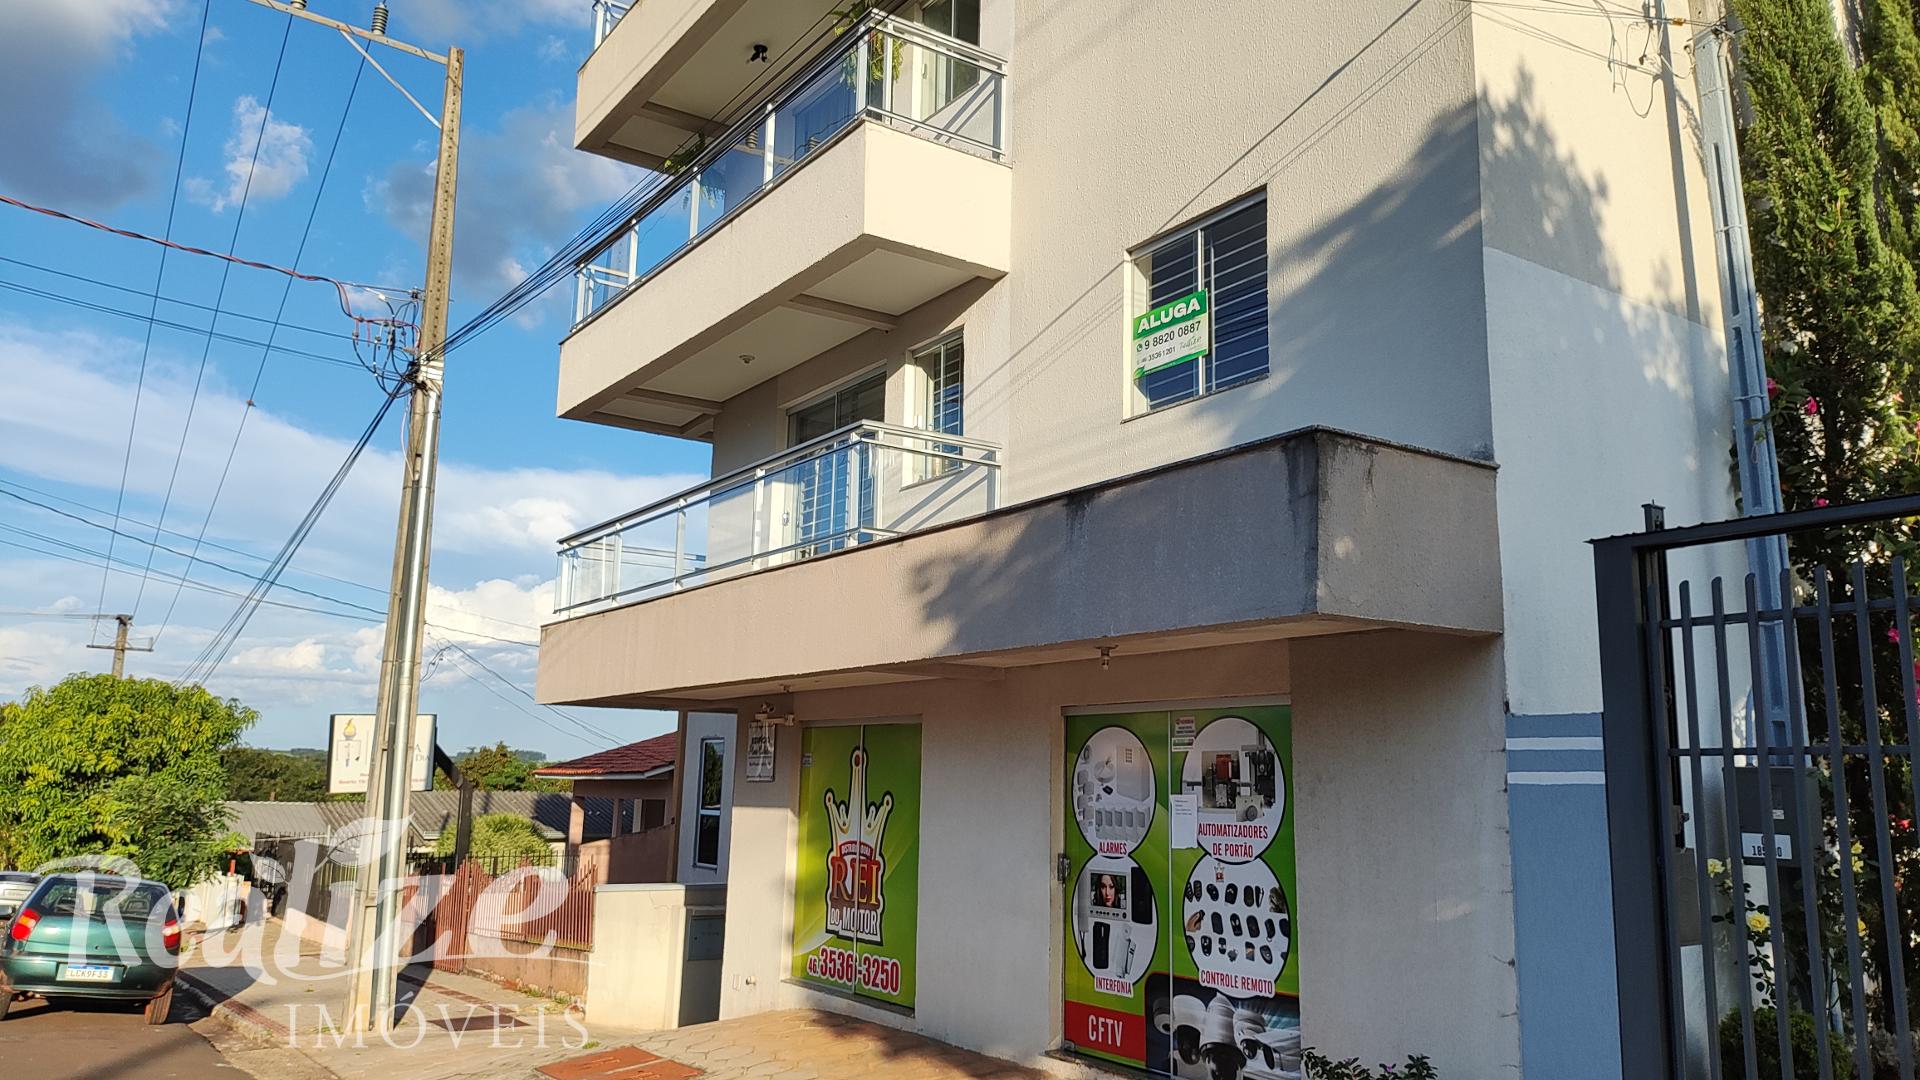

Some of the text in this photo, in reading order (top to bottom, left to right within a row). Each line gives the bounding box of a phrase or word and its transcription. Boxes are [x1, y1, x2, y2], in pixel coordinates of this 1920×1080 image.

[1138, 297, 1200, 334] ALUGA
[1144, 320, 1201, 350] 9 8820 0887
[1198, 823, 1268, 839] AUTOMATIZADORES
[1099, 841, 1128, 856] ALARMES
[1212, 842, 1254, 858] DE PORTÃO
[832, 860, 879, 904] REI
[830, 906, 878, 935] DO MOTOR
[1095, 976, 1132, 995] INTERFONIA
[1200, 970, 1273, 995] CONTROLE REMOTO
[1088, 1014, 1123, 1047] CFTV
